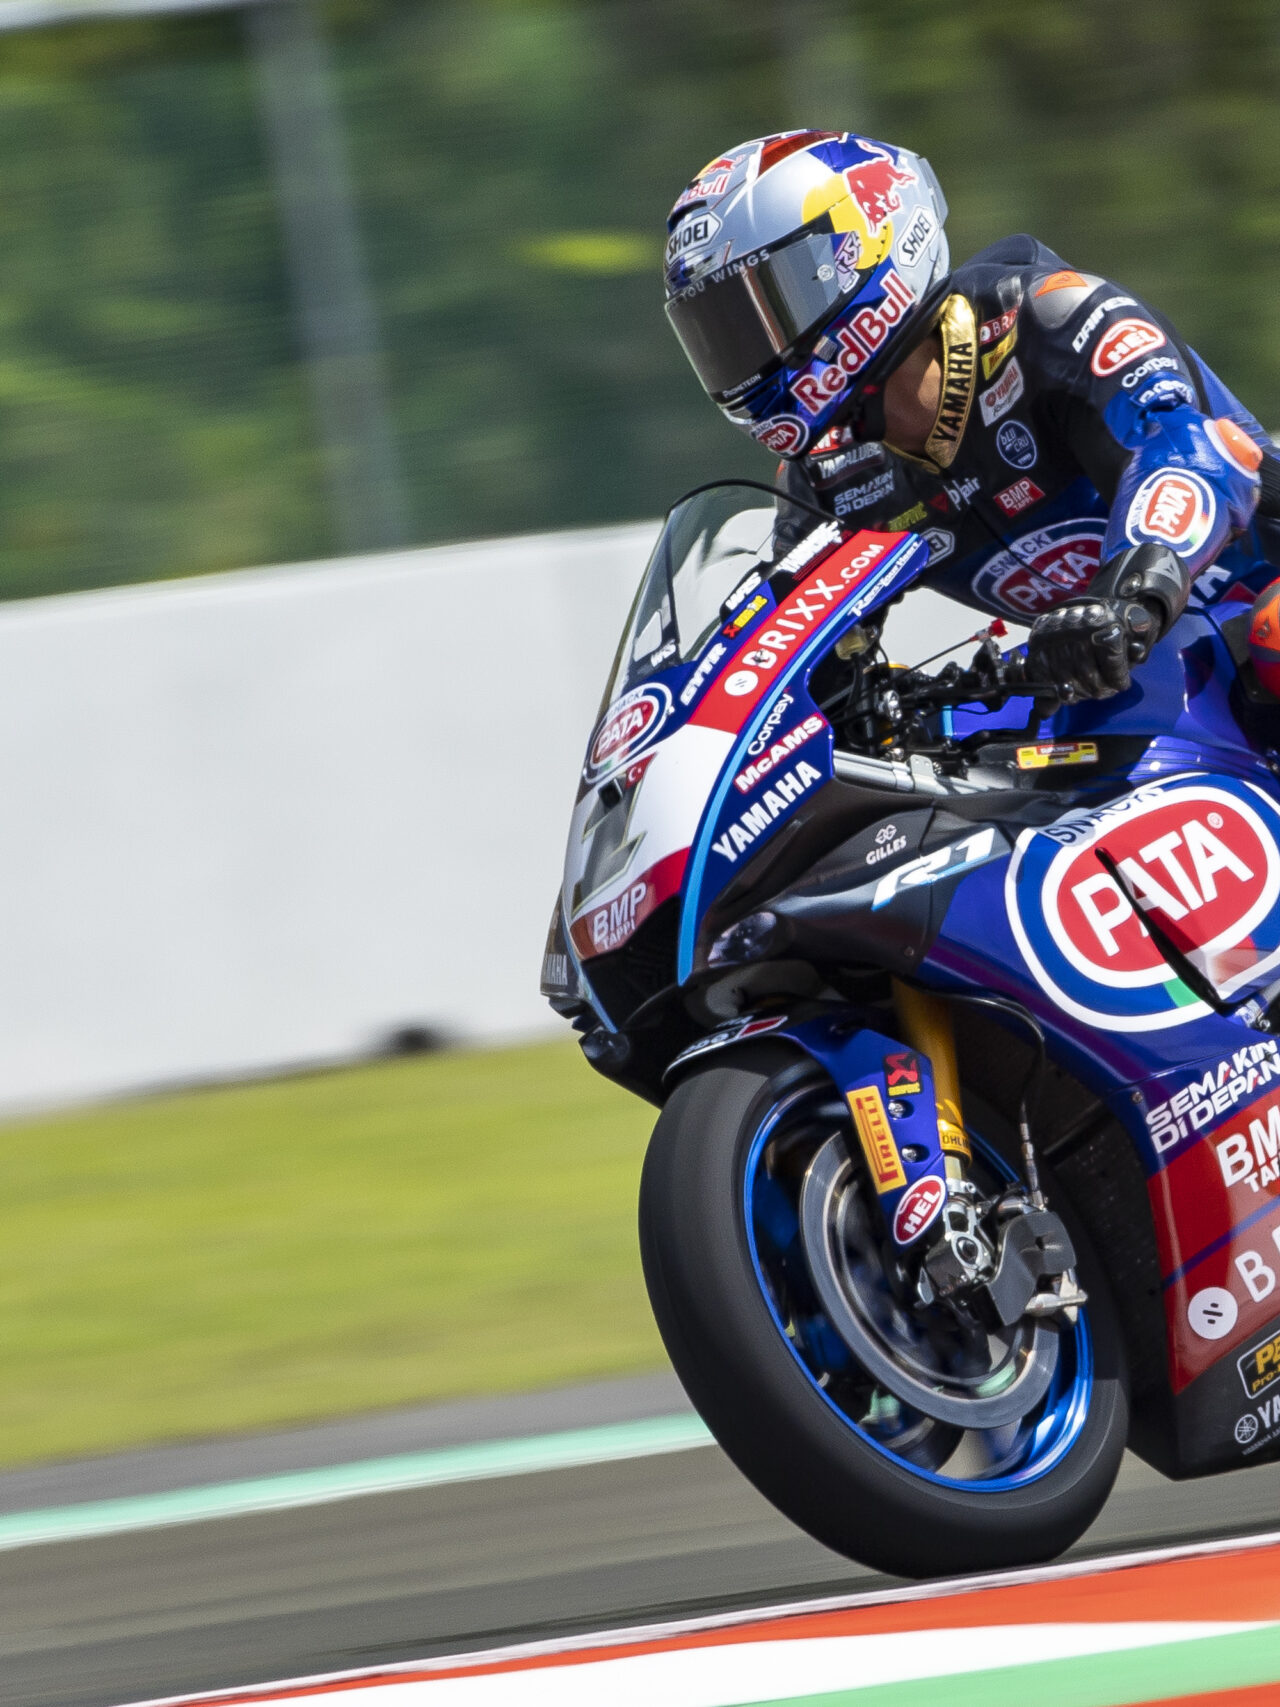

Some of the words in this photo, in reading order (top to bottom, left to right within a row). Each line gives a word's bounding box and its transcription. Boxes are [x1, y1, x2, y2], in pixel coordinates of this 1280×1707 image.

[668, 219, 709, 259] SHOEI
[902, 216, 931, 260] SHOEI
[710, 249, 771, 284] WINGS
[932, 341, 973, 443] YAMAHA
[999, 480, 1032, 509] BMP
[989, 531, 1049, 578] SNACK
[746, 690, 795, 757] Corpay
[734, 715, 825, 793] McAMS
[711, 760, 822, 863] YAMAHA
[865, 833, 907, 866] GILLES
[871, 827, 996, 912] R1
[593, 881, 648, 946] BMP
[1070, 818, 1255, 958] PATA
[601, 916, 636, 951] TAPPI
[854, 1095, 899, 1184] PIRELLI
[903, 1189, 941, 1234] HEL
